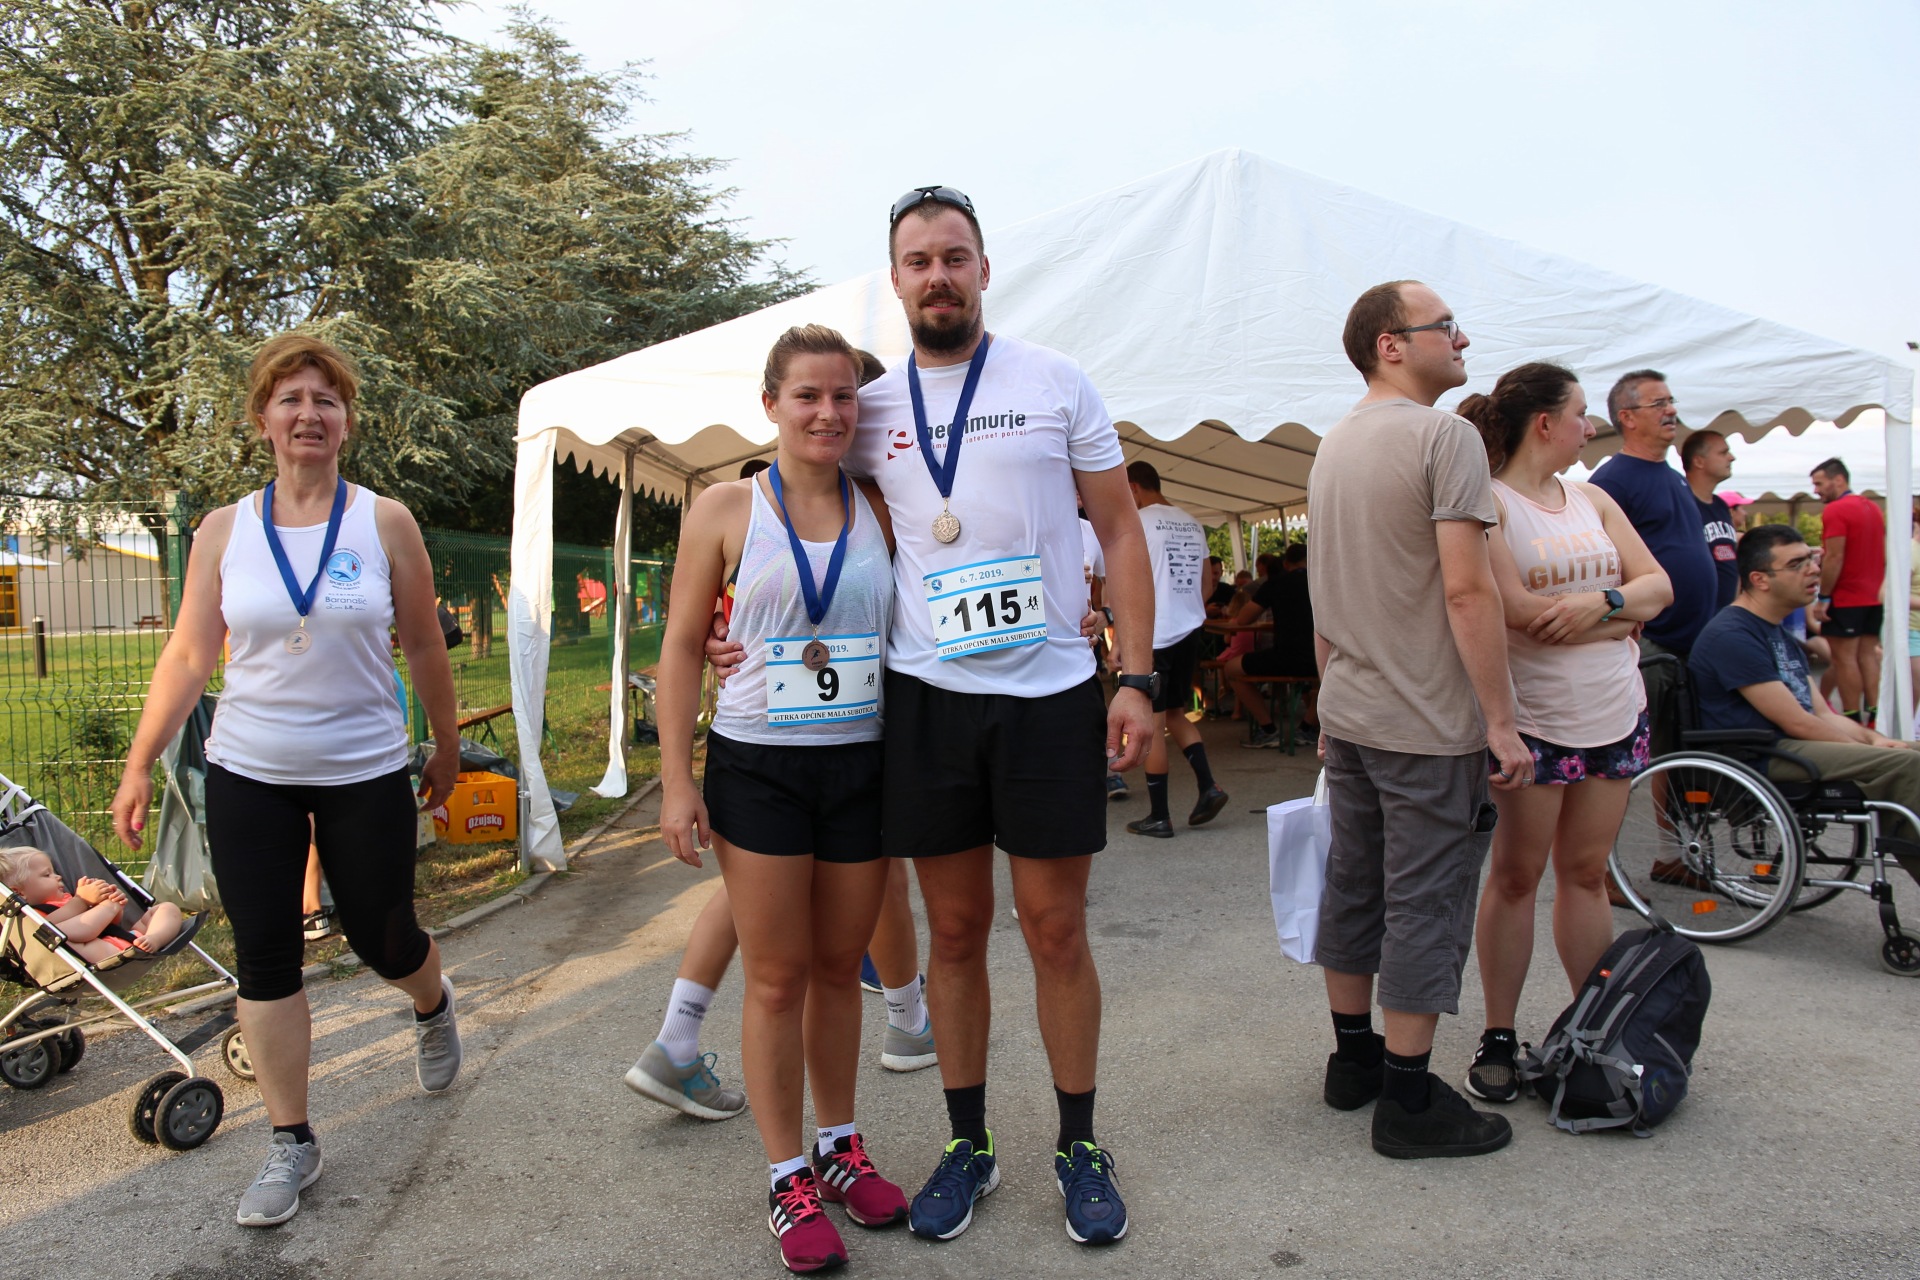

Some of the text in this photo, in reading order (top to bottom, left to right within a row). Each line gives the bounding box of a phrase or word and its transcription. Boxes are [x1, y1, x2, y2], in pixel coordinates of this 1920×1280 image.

[966, 433, 998, 444] internet
[1001, 429, 1027, 438] portal
[1530, 528, 1614, 561] THAT'S
[979, 568, 1004, 580] 2019.
[325, 596, 368, 605] Baranašić
[954, 589, 1022, 632] 115
[942, 630, 1043, 655] UTRKA OPĆINE MALA SUBOTICA
[816, 667, 840, 702] 9
[774, 706, 874, 722] UTRKA OPĆINE MALA SUBOTICA
[468, 814, 502, 829] Ožujsko
